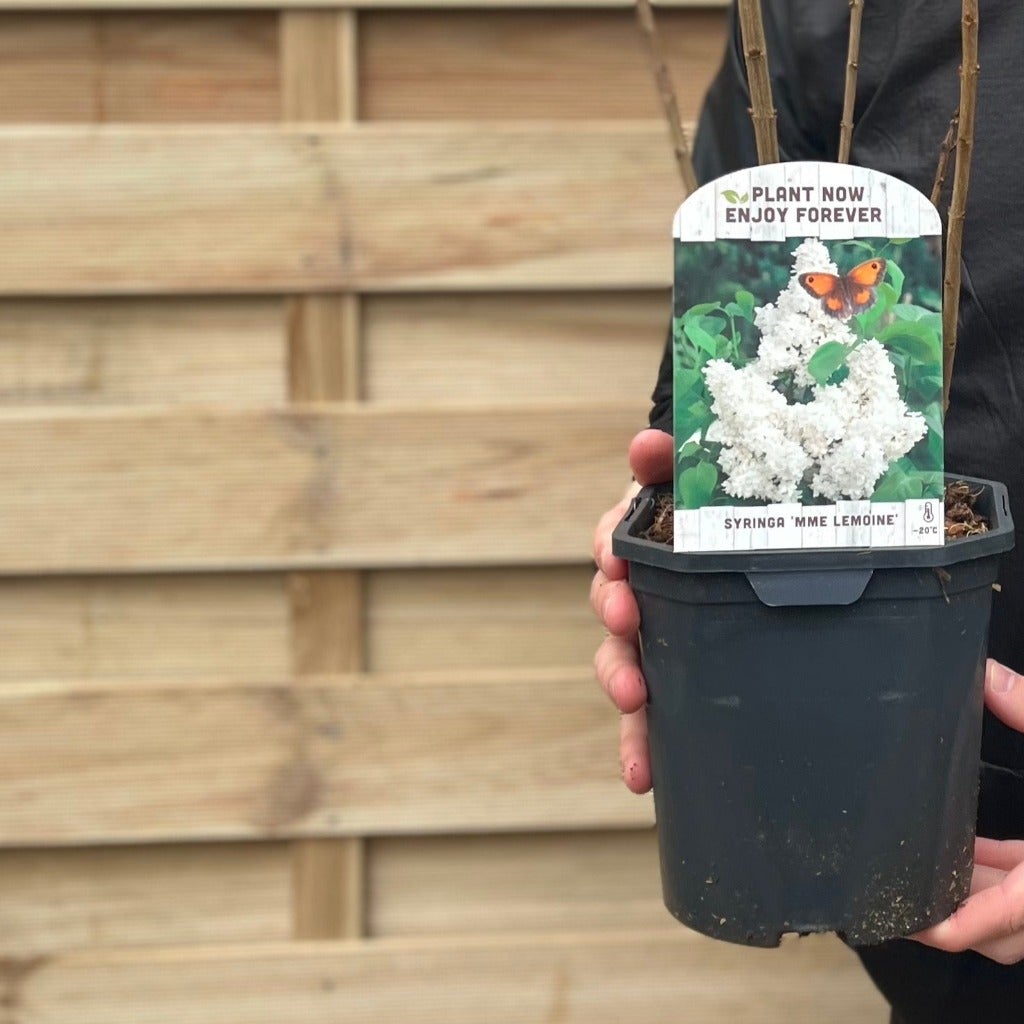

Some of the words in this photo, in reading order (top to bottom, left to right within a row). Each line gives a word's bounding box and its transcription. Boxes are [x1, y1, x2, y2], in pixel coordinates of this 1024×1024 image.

[752, 186, 814, 202] PLANT
[822, 186, 865, 202] NOW
[725, 207, 789, 223] ENJOY
[796, 207, 882, 223] FOREVER
[724, 517, 785, 529] SYRINGA
